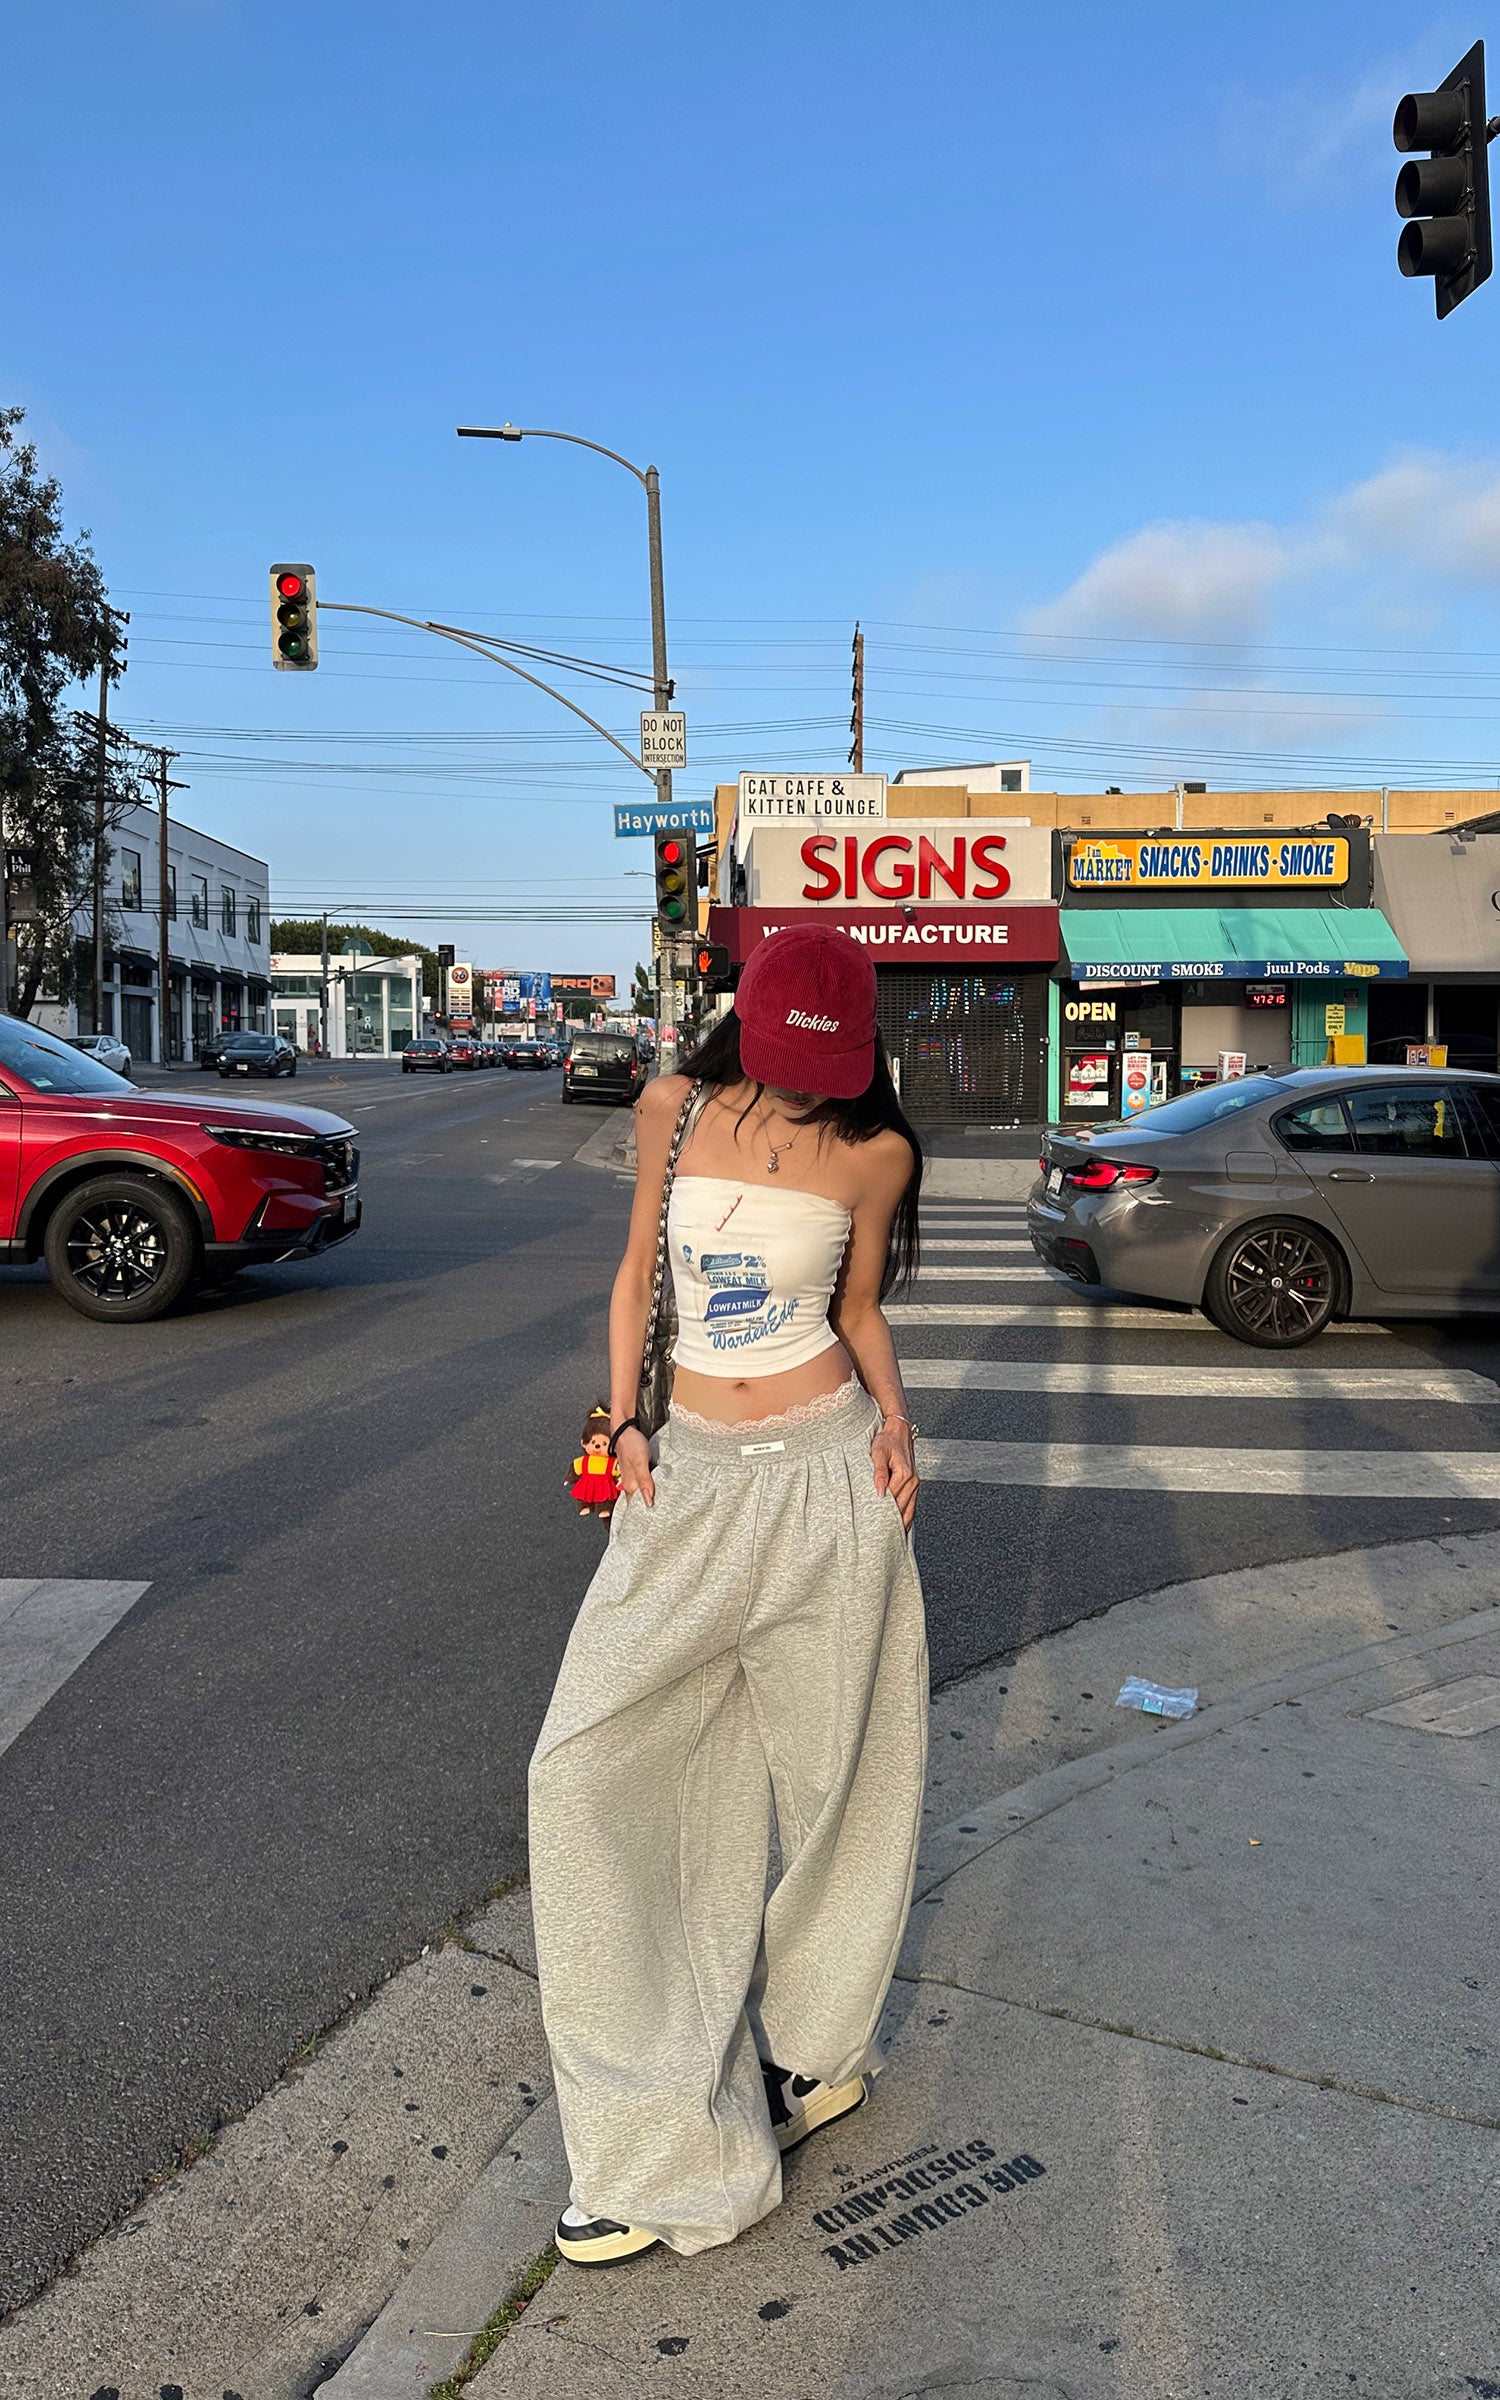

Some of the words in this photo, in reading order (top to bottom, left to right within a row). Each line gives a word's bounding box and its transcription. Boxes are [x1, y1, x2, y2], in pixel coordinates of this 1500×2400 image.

[643, 719, 657, 732] DO
[663, 719, 683, 732] NOT
[643, 737, 684, 751] BLOCK
[643, 753, 684, 763] INTERSECTION
[748, 779, 777, 795] CAT
[785, 780, 825, 795] CAFE
[832, 780, 845, 795] &
[748, 799, 806, 814] KITTEN
[815, 800, 880, 815] LOUNGE.
[618, 809, 710, 832] Hayworth
[11, 856, 23, 864] LA
[800, 835, 1011, 900] SIGNS
[1139, 846, 1201, 878] SNACKS
[1211, 845, 1270, 877] DRINKS
[1279, 844, 1335, 876] SMOKE
[12, 864, 31, 873] Phil
[1073, 858, 1133, 881] MARKET
[836, 925, 1008, 944] NUFACTURE
[1085, 964, 1162, 978] DISCOUNT
[1171, 963, 1224, 977] SMOKE
[1264, 962, 1293, 977] juul
[1297, 962, 1330, 974] Pods
[550, 978, 591, 988] PRO
[1065, 1002, 1116, 1021] OPEN
[786, 1009, 840, 1033] Dickies
[743, 1255, 766, 1268] 2%
[707, 1276, 742, 1285] LOWFAT
[745, 1277, 767, 1286] MILK
[709, 1303, 741, 1313] LOWFAT
[742, 1299, 762, 1310] MILK
[861, 2143, 940, 2185] FEBRUARY
[981, 2154, 1047, 2194] BIG
[821, 2183, 989, 2271] COUNTRY
